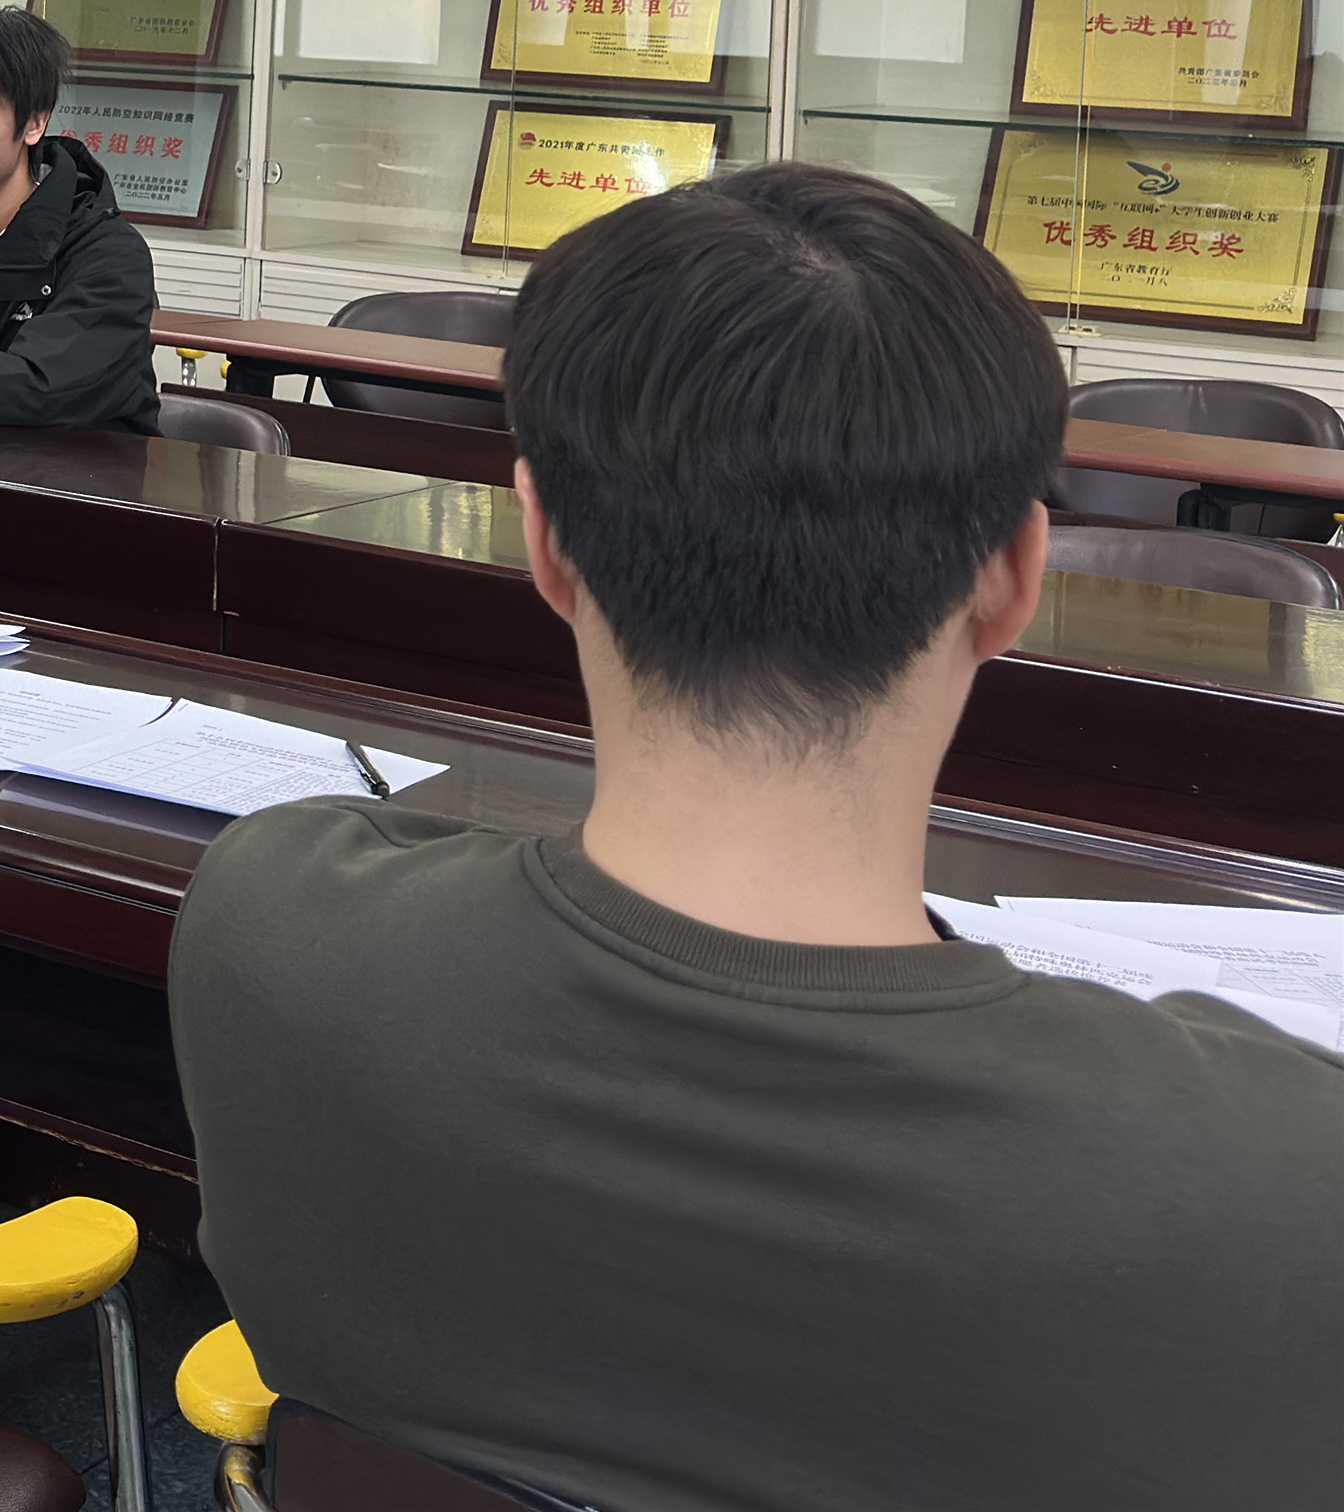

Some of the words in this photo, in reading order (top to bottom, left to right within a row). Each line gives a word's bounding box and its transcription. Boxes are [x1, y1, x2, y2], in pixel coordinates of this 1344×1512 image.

[1083, 12, 1238, 41] 先进单位
[58, 104, 196, 124] 2022年人民防空知识网络竞赛
[524, 167, 650, 195] 先进单位
[1042, 219, 1245, 261] 优秀组织奖
